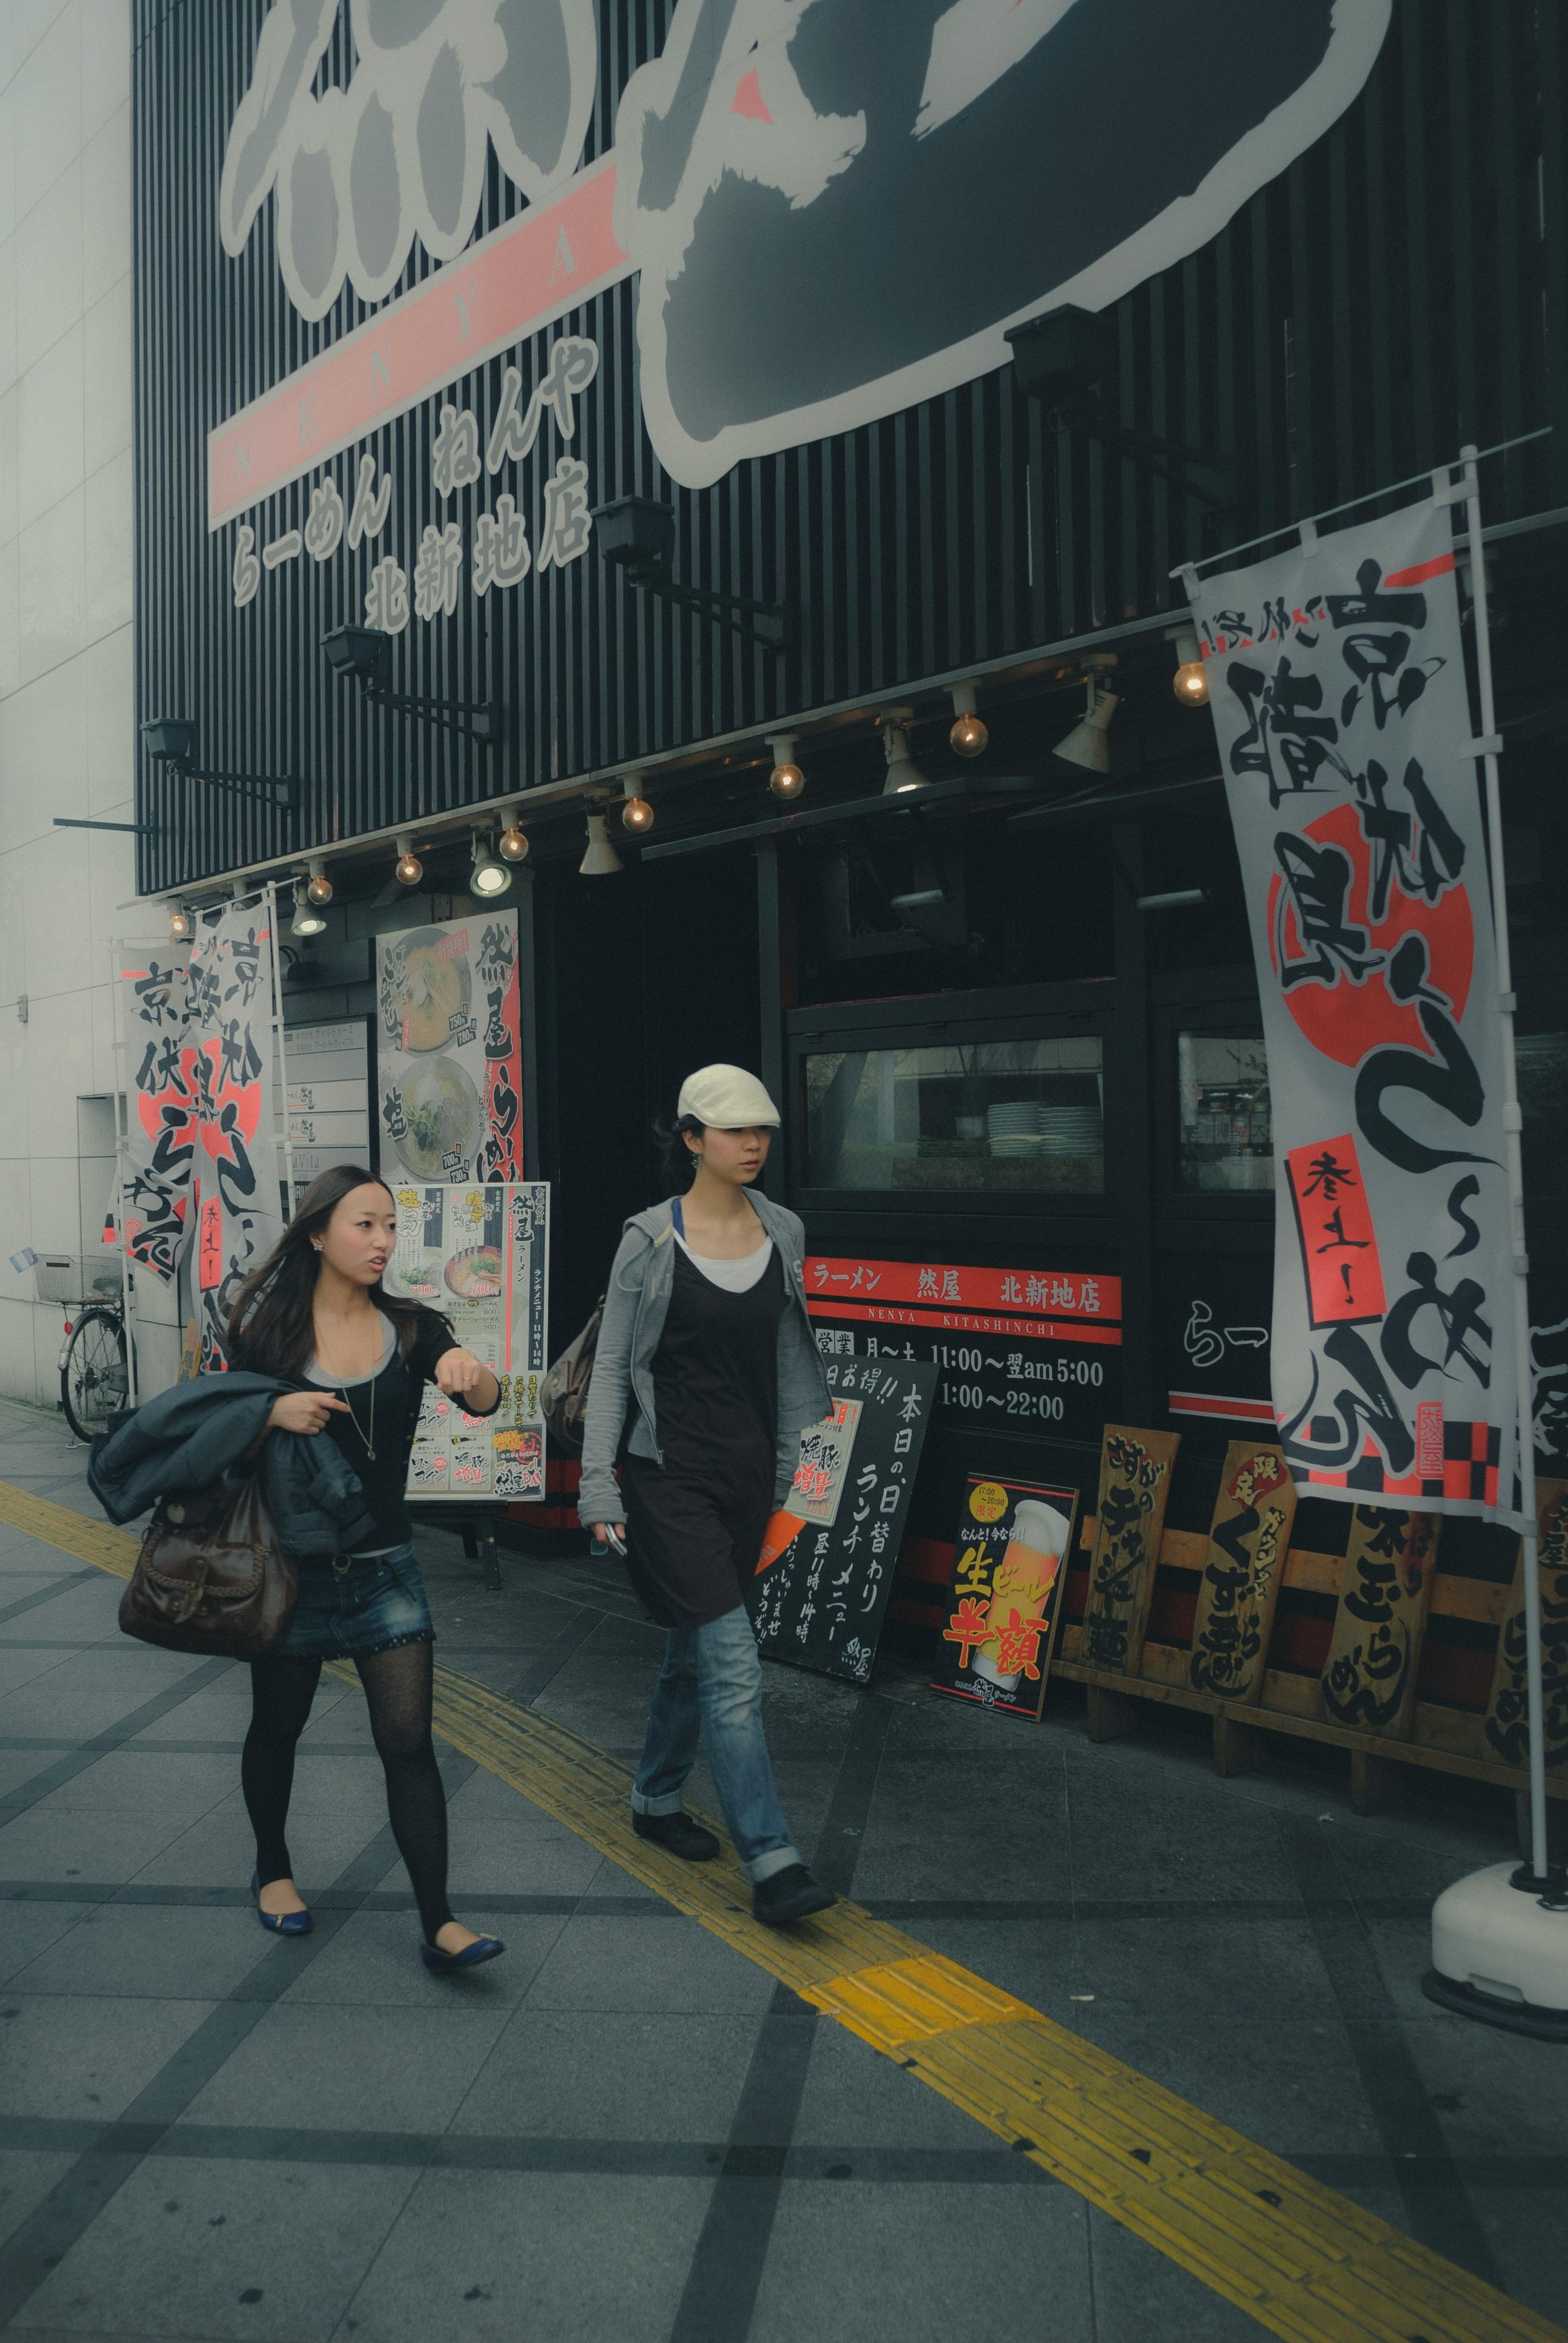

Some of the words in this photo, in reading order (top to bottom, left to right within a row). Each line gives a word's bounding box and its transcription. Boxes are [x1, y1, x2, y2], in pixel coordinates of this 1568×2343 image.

[232, 223, 577, 486] NENYA
[234, 454, 391, 607] らーめん
[433, 336, 599, 499] ねんや
[364, 456, 592, 634] 北新地店
[476, 923, 514, 1060] 然屋
[508, 1194, 535, 1242] 然屋
[517, 1244, 526, 1282] ラーメン
[410, 1284, 440, 1296] 700円
[470, 1283, 500, 1296] 700円
[534, 1269, 542, 1320] ランチメニュー
[814, 1263, 881, 1291] ラーメン
[917, 1268, 962, 1302] 然屋
[1001, 1275, 1102, 1313] 北新地店
[868, 1308, 916, 1322] NENYA
[943, 1316, 1056, 1335] KITASHINCHI
[800, 1434, 841, 1470] 焼豚
[793, 1462, 833, 1499] 増量
[978, 1487, 995, 1495] 17:00
[1230, 1455, 1278, 1506] 限定
[805, 1499, 832, 1517] DAY
[975, 1506, 997, 1519] 限定
[826, 1464, 877, 1642] ランチメニュー
[961, 1527, 989, 1541] なんと!
[955, 1541, 1054, 1602] 生ビール
[943, 1597, 1050, 1680] 半額
